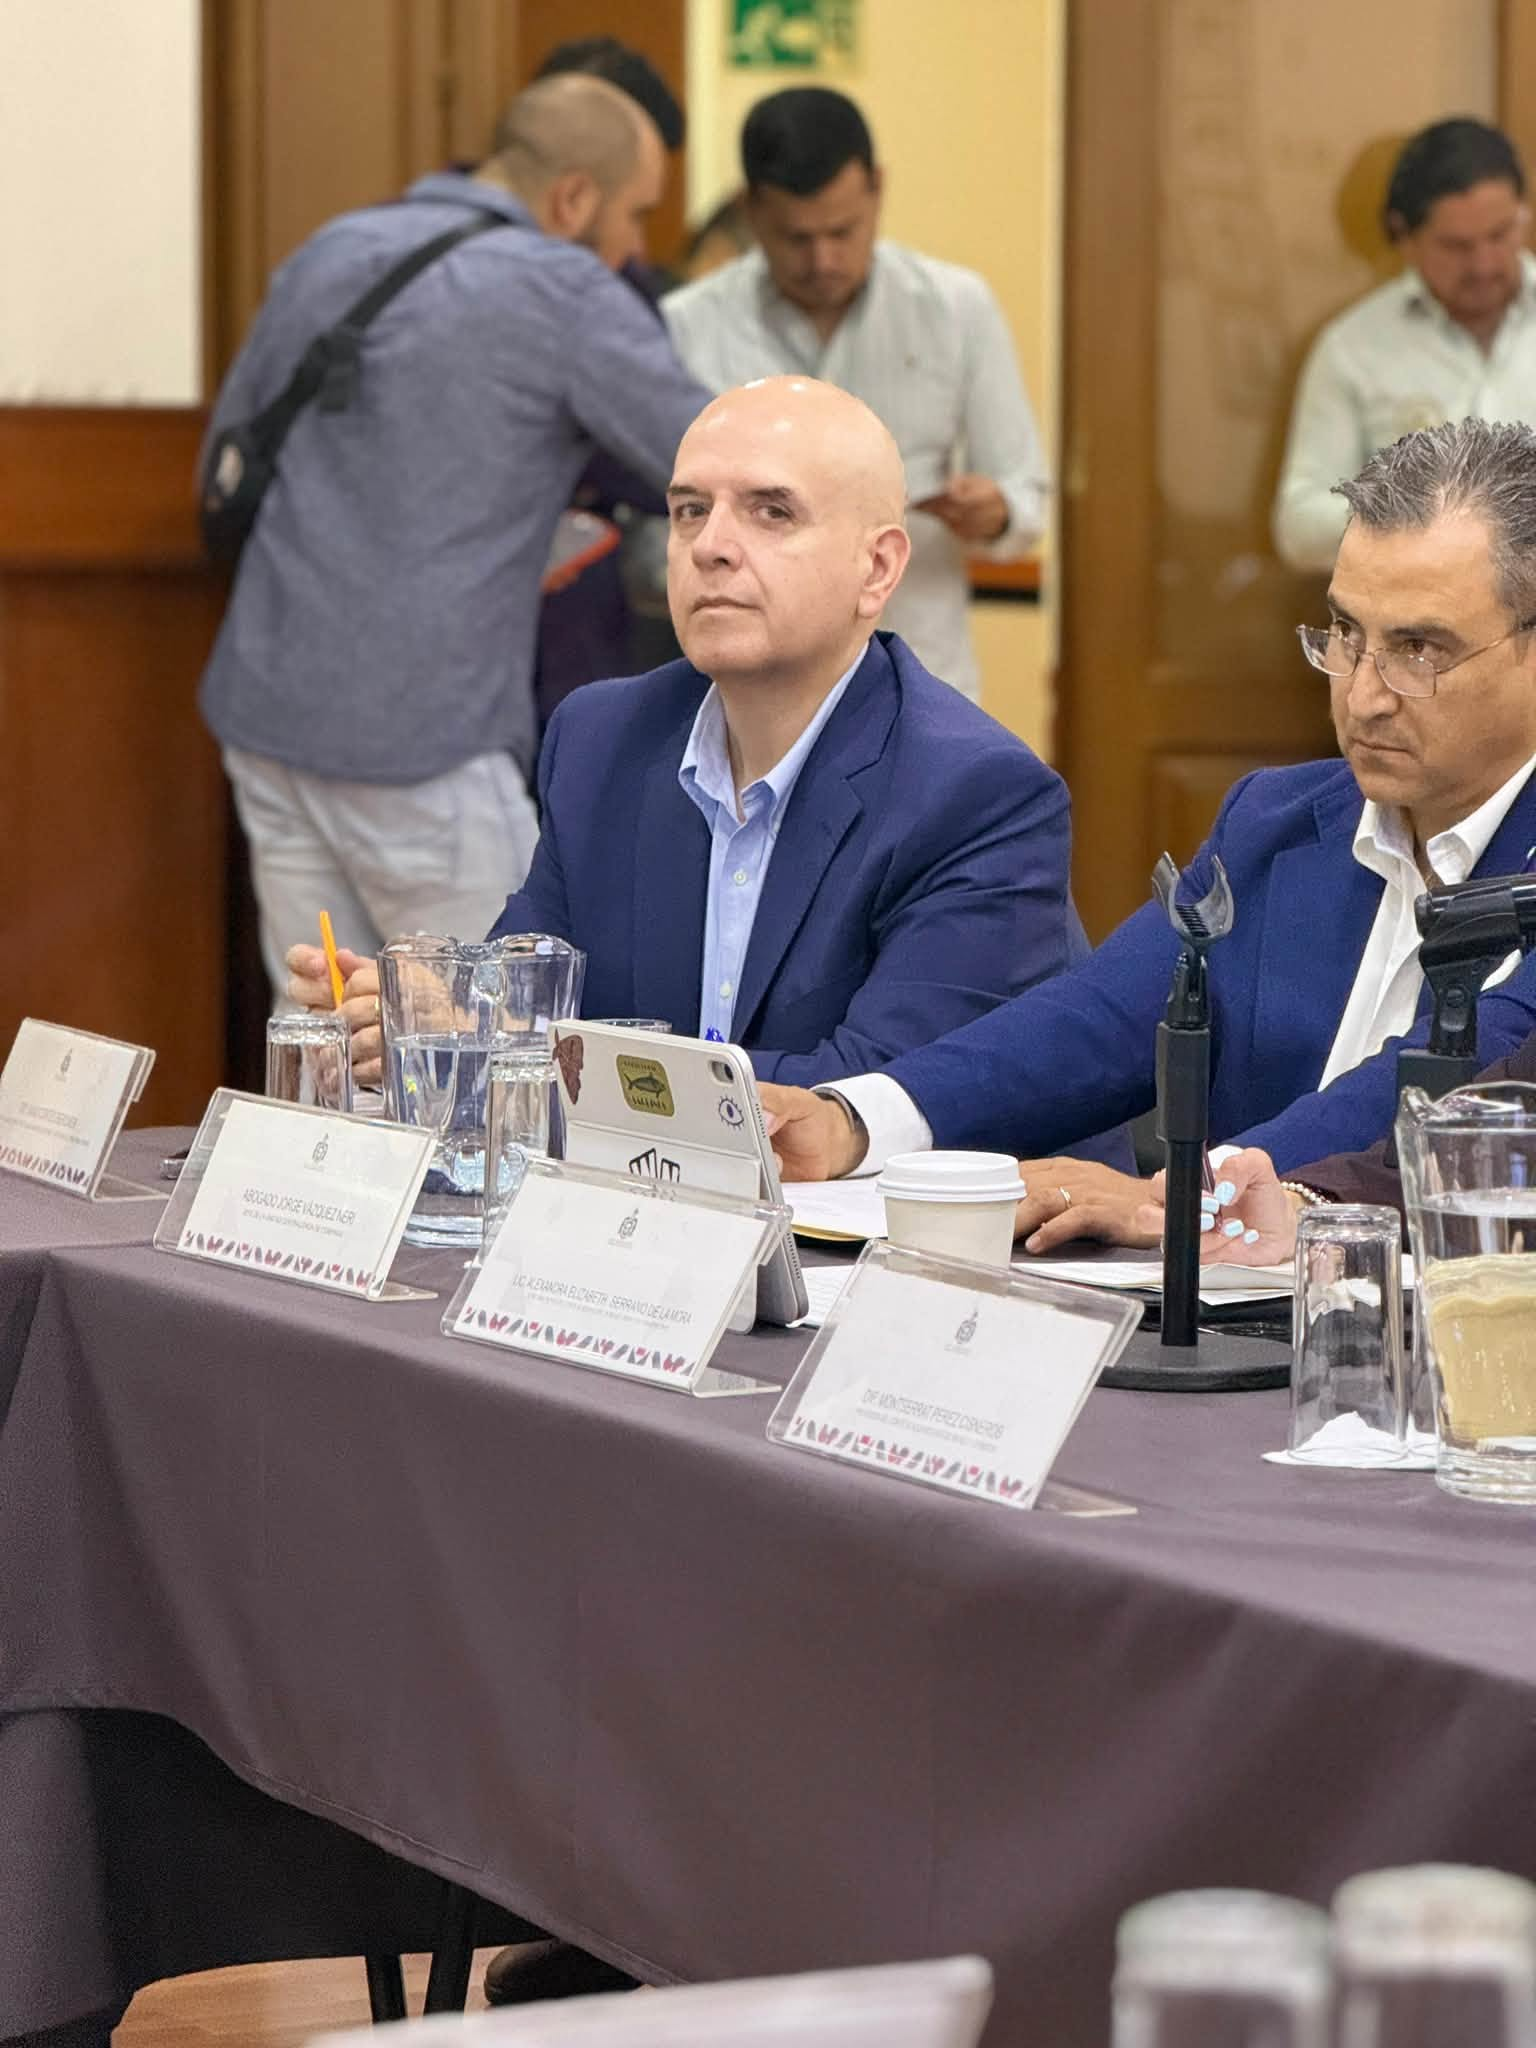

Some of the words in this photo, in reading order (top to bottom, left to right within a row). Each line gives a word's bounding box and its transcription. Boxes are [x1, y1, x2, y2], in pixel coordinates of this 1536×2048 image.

[242, 1188, 278, 1208] ABOGADO
[277, 1195, 304, 1214] JORGE
[336, 1207, 357, 1225] NERI
